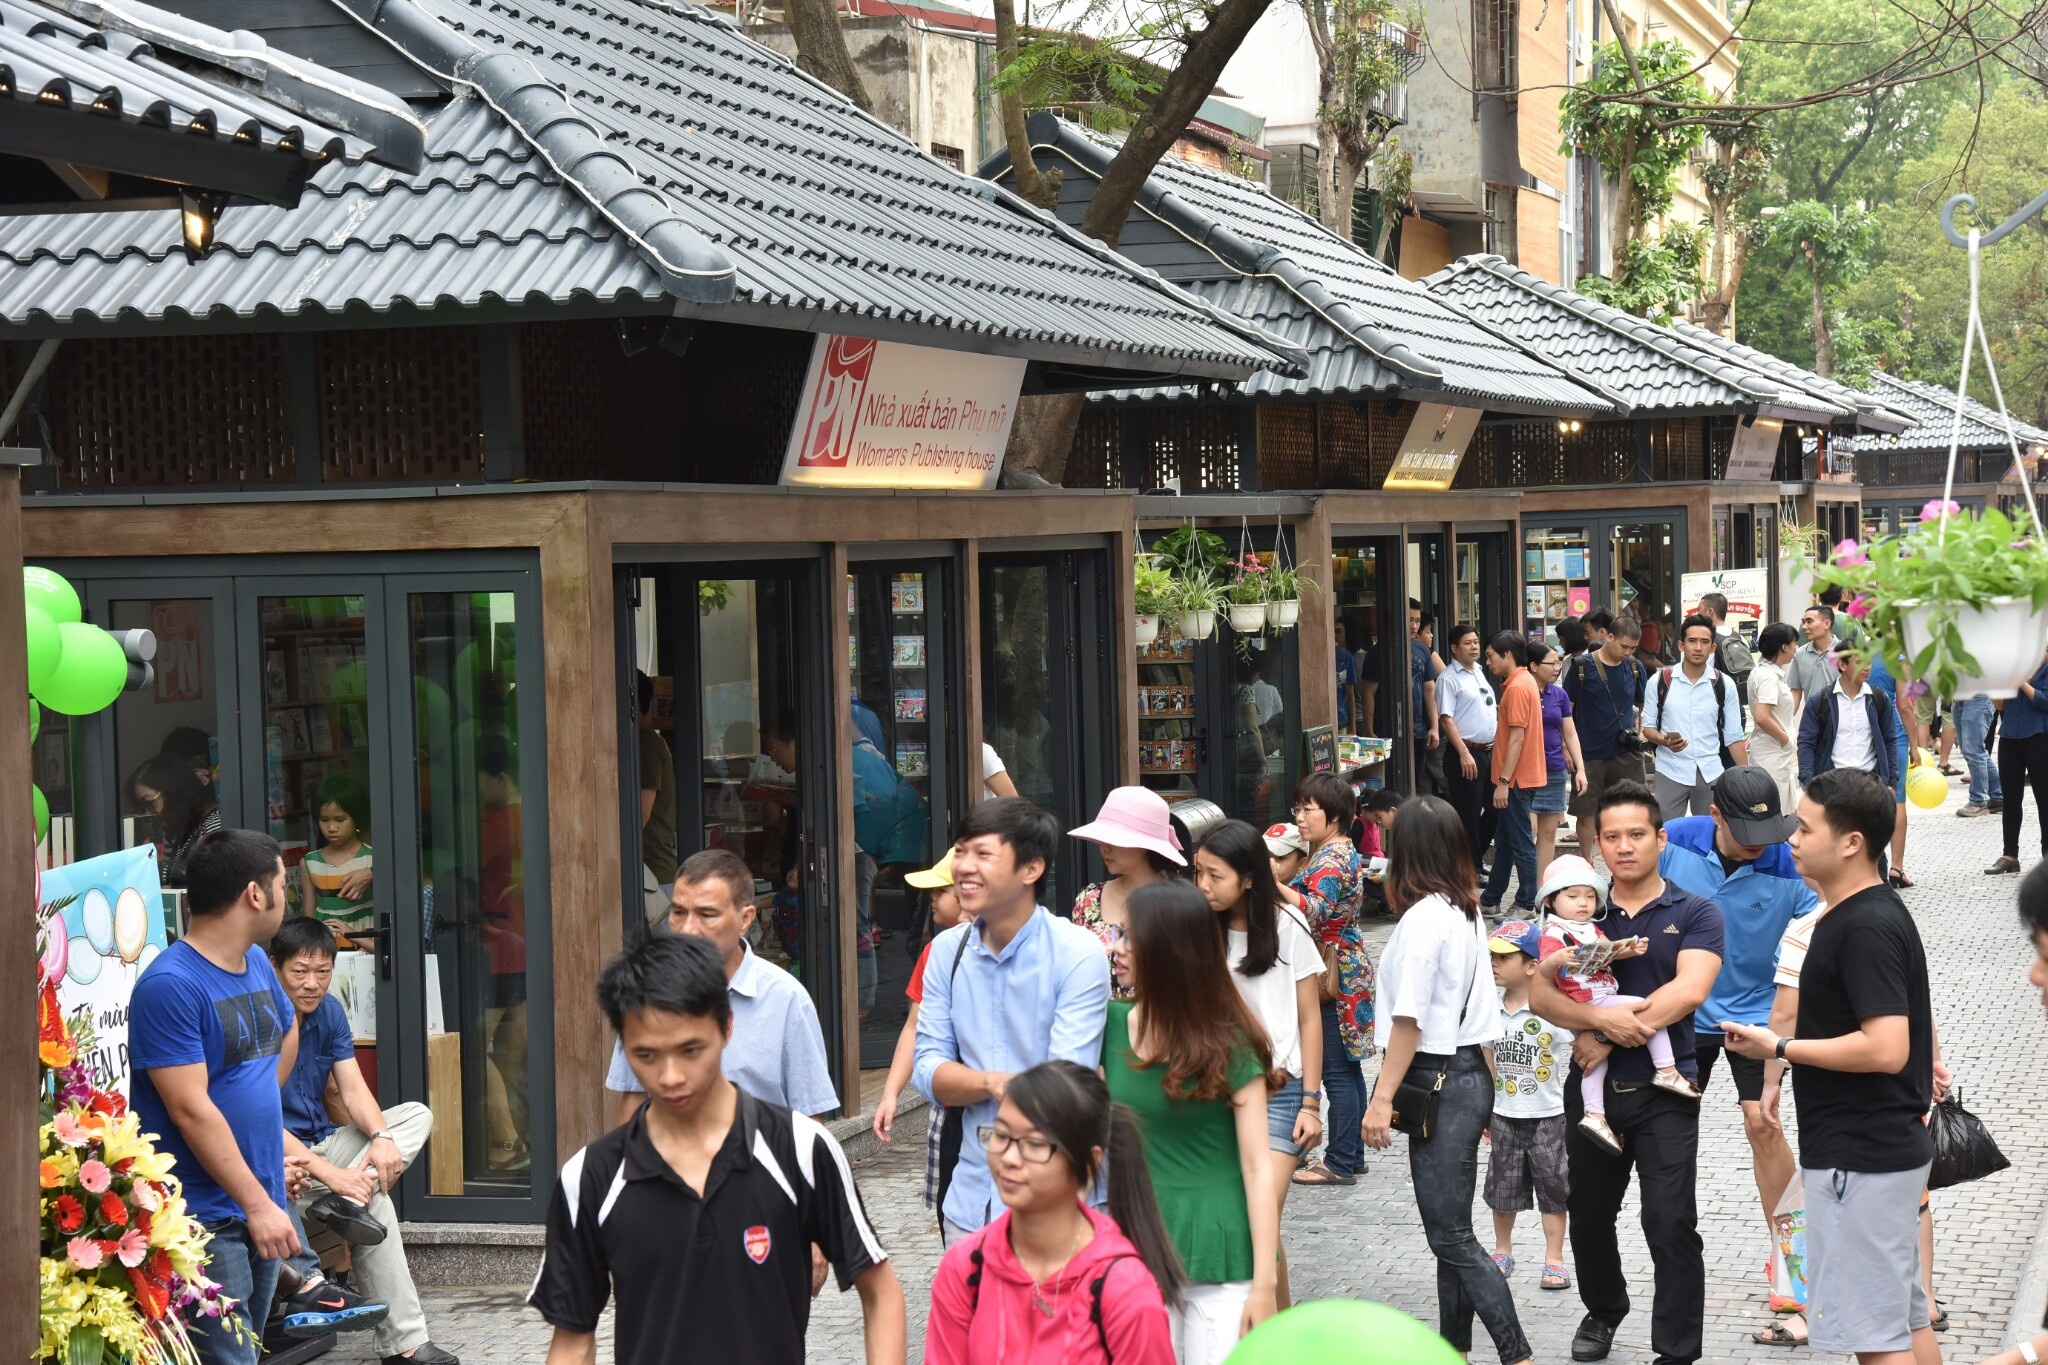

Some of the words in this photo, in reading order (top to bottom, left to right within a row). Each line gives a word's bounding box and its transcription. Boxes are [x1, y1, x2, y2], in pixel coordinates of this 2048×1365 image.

[864, 393, 896, 428] Nhà
[897, 389, 930, 429] xuất
[930, 396, 957, 430] bản
[959, 400, 986, 437] Phụ
[988, 404, 1008, 434] nữ
[855, 441, 908, 467] Women's
[910, 442, 964, 474] Publishing
[964, 445, 996, 471] house
[118, 1042, 129, 1079] P
